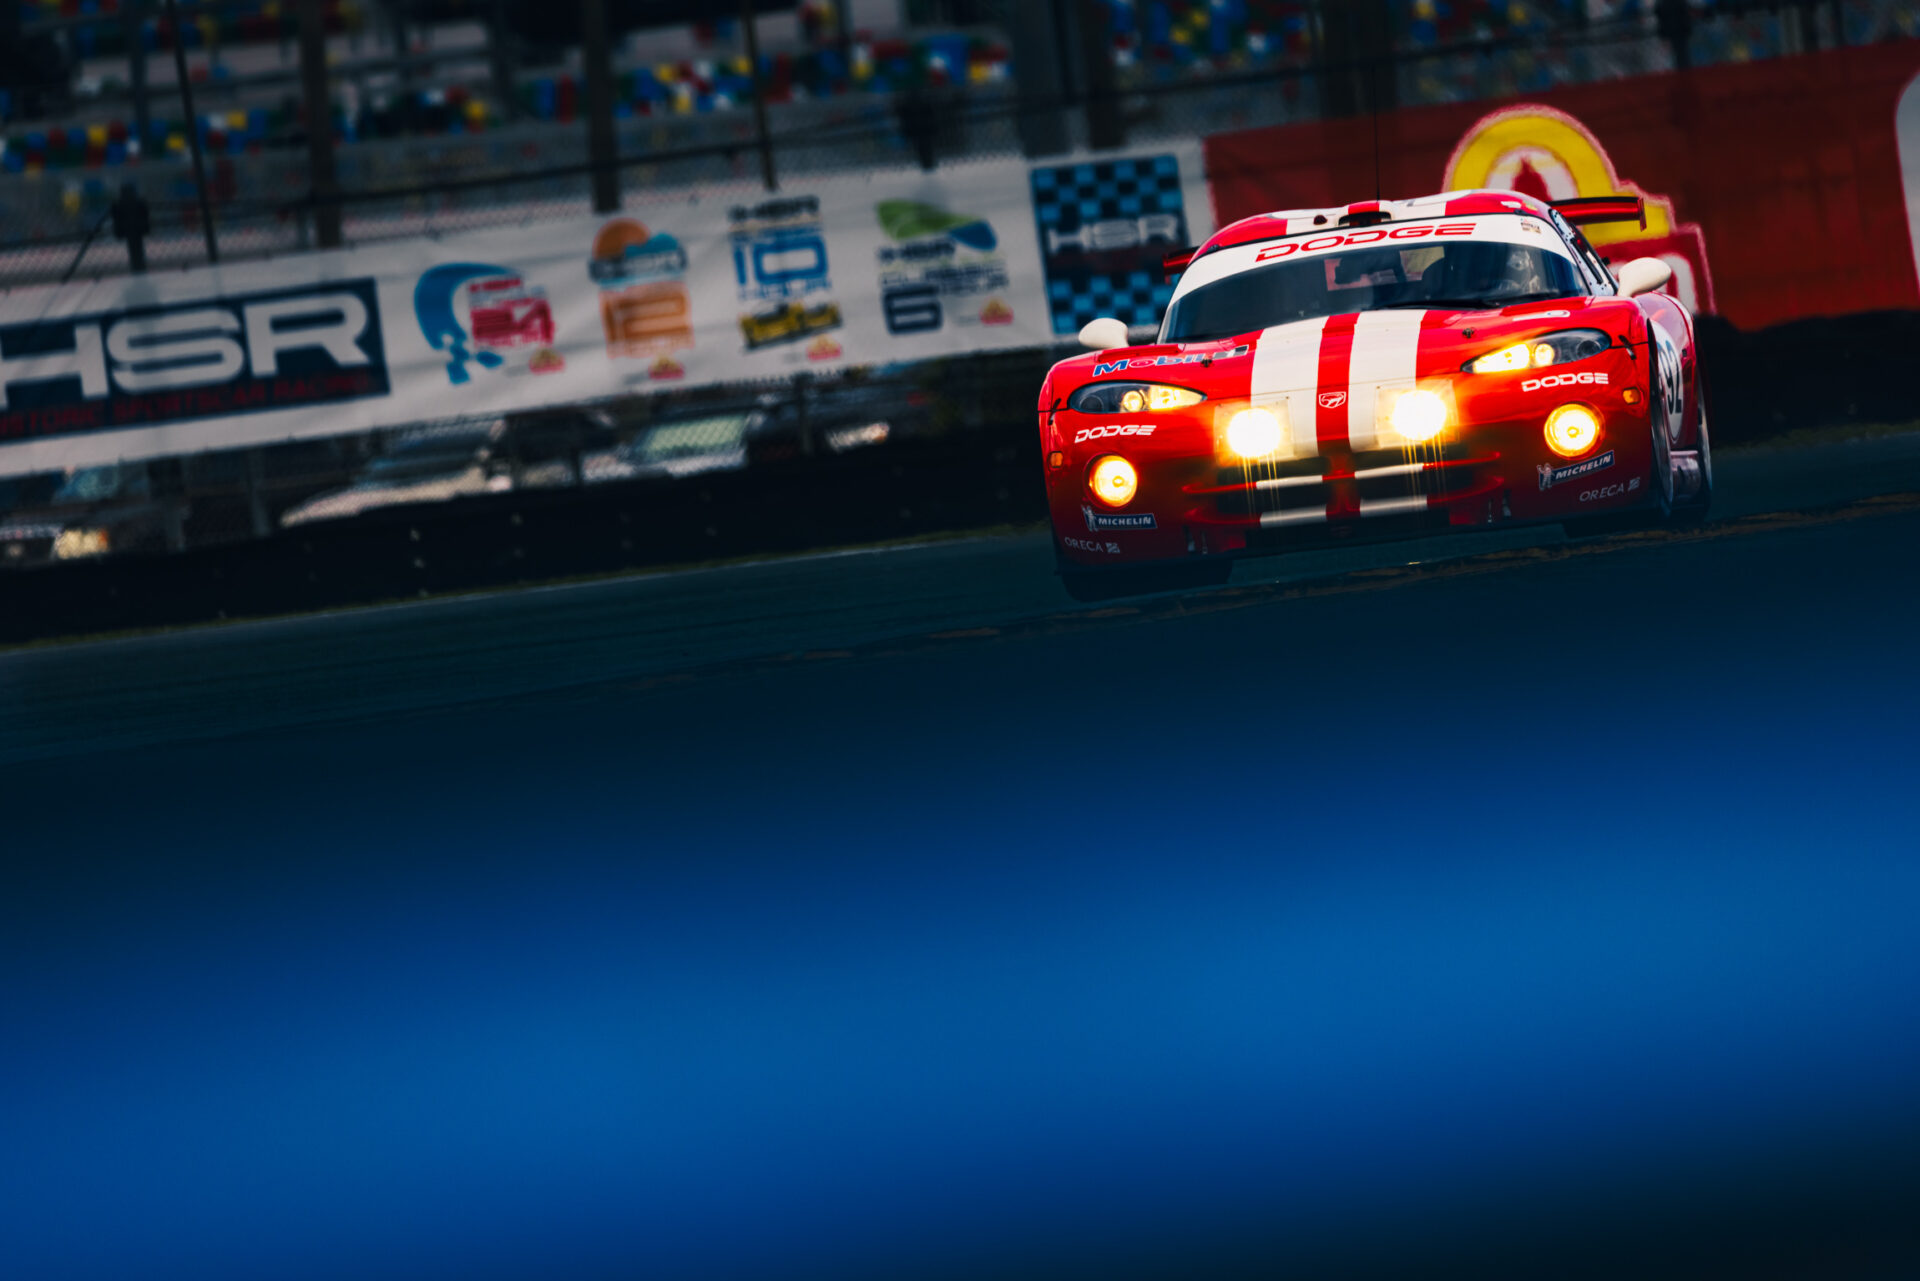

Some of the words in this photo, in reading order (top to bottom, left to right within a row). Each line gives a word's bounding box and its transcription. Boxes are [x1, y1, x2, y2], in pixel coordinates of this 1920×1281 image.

[1048, 213, 1180, 254] HSR
[1255, 223, 1477, 262] DODGE
[0, 292, 371, 409] HSR
[273, 369, 371, 400] RACING
[1521, 371, 1609, 392] DODGE
[1656, 340, 1682, 415] 92
[1074, 425, 1157, 443] DODGE
[1555, 454, 1612, 480] MICHELIN
[1579, 484, 1625, 502] ORECA
[1098, 516, 1153, 526] MICHELIN
[1064, 537, 1104, 553] ORECA
